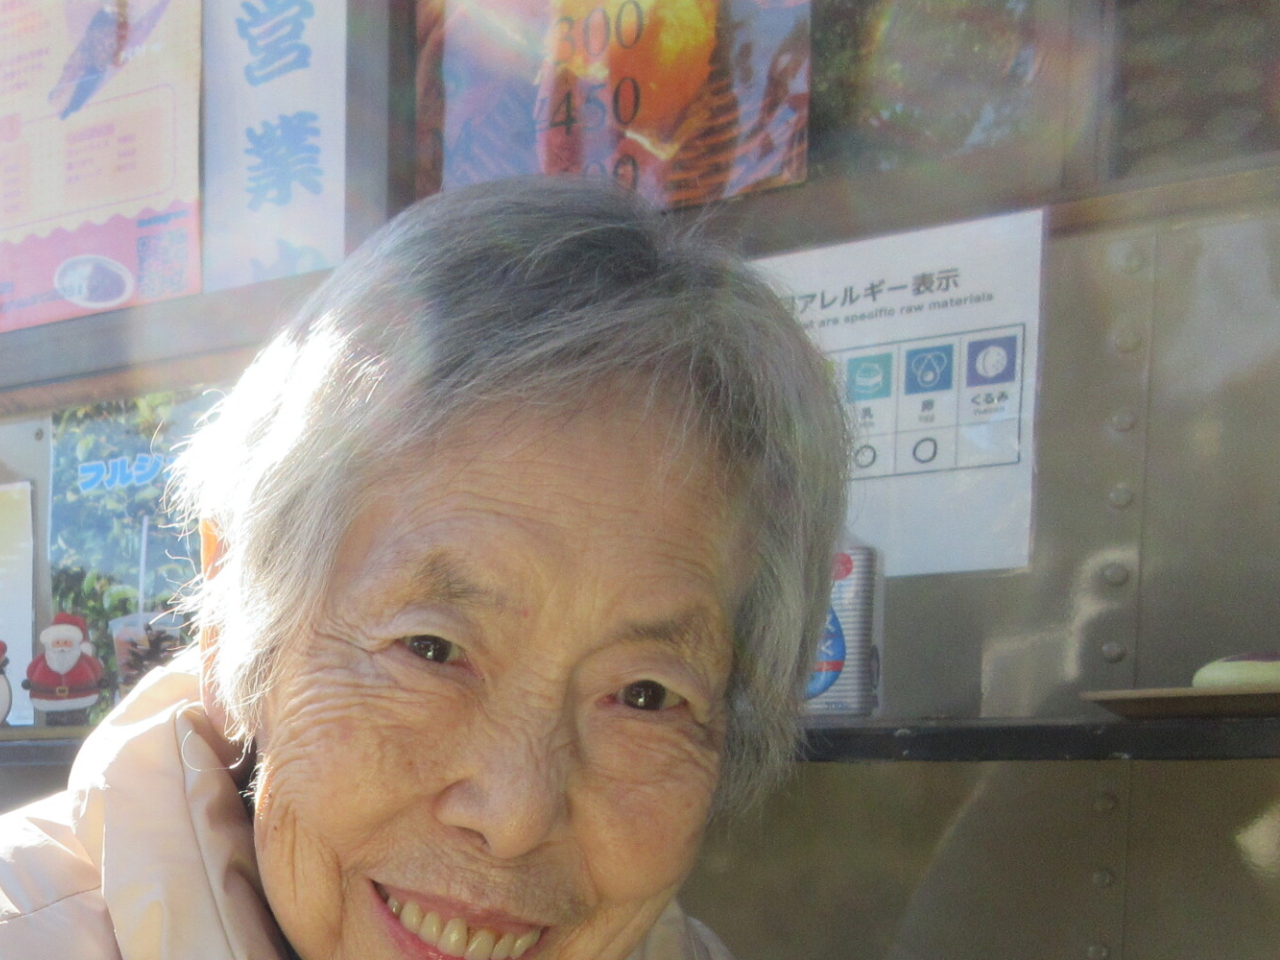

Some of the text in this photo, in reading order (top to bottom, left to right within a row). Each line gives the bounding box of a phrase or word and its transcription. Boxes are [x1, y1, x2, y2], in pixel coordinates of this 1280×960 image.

[788, 267, 960, 314] アレルギー表示
[843, 306, 896, 326] specific
[899, 304, 925, 316] raw
[928, 291, 994, 309] materials
